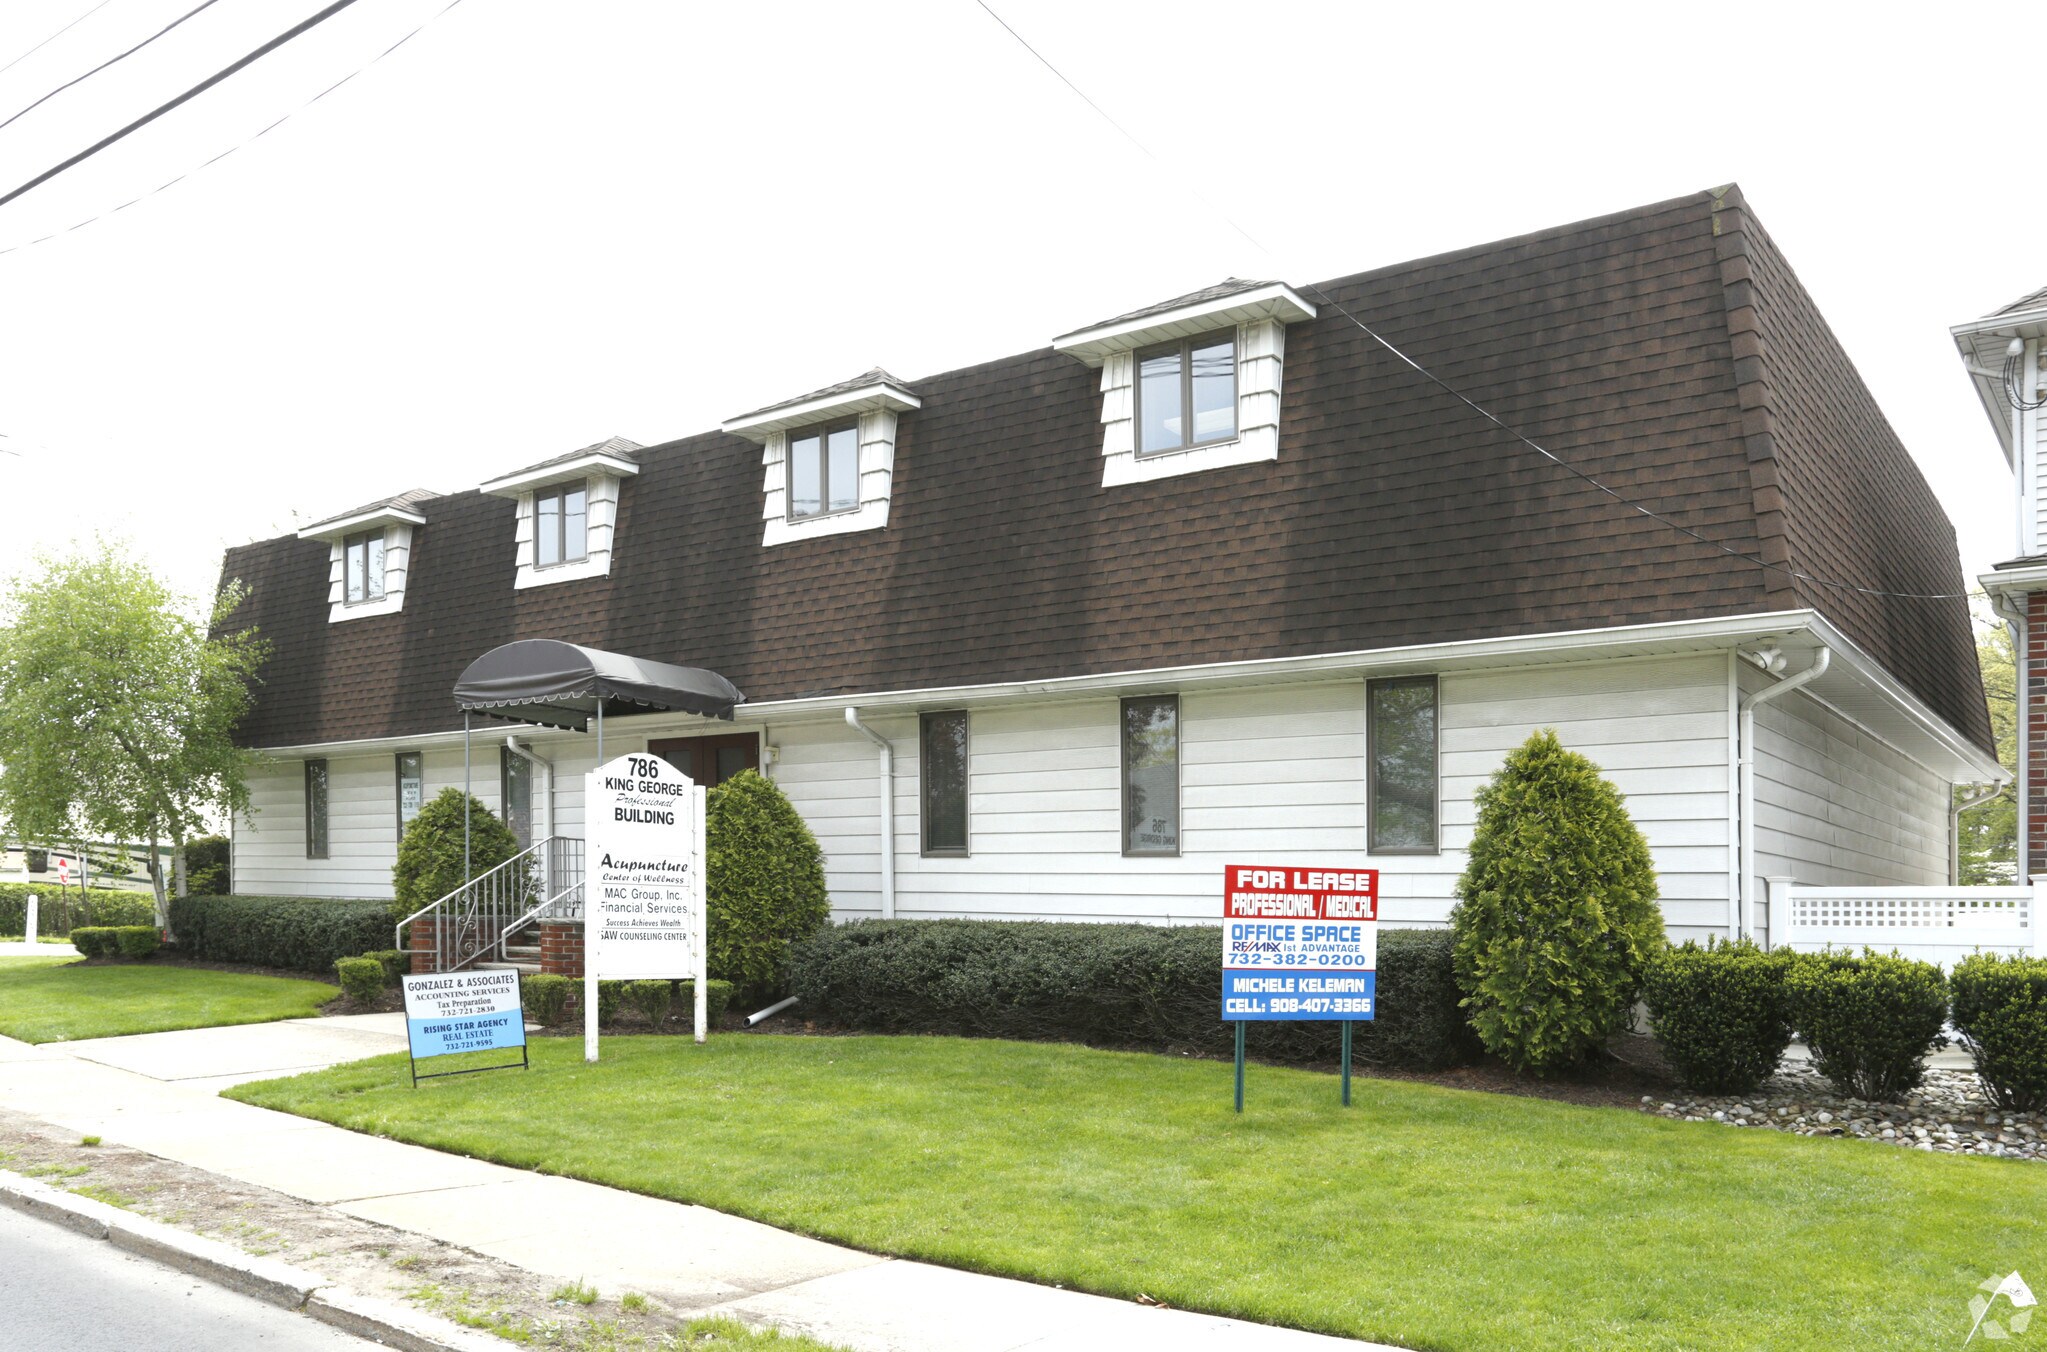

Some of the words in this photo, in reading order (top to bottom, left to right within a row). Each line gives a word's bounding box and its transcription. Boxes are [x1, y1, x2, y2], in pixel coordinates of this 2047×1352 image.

[628, 757, 659, 779] 786
[605, 777, 634, 791] KING
[638, 781, 683, 797] GEORGE
[615, 793, 676, 808] Professional
[615, 807, 675, 825] BUILDING
[601, 853, 688, 872] Acupuncture
[602, 873, 630, 881] Center
[632, 874, 642, 883] of
[643, 874, 684, 885] Wellness
[1237, 870, 1286, 889] FOR
[1293, 871, 1370, 892] LEASE
[605, 888, 627, 899] MAC
[666, 890, 683, 901] Inc.
[646, 902, 688, 914] Services
[1231, 892, 1317, 917] PROFESSIONAL
[1325, 894, 1374, 919] MEDICAL
[606, 918, 630, 927] Success
[631, 918, 659, 928] Achieves
[660, 919, 681, 927] Wealth
[619, 932, 662, 942] COUNSELING
[664, 932, 687, 941] CENTER
[1231, 924, 1295, 942] OFFICE
[1301, 925, 1361, 943] SPACE
[1232, 941, 1282, 953] RE/MAX
[1301, 944, 1360, 953] ADVANTAGE
[1228, 953, 1366, 966] 732-382-0200
[408, 980, 454, 991] GONZALEZ
[456, 979, 464, 988] &
[466, 974, 515, 987] ASSOCIATES
[1233, 978, 1295, 993] MICHELE
[1298, 978, 1365, 993] KELEMAN
[414, 990, 470, 1001] ACCOUNTING
[471, 987, 511, 997] SERVICES
[437, 1001, 451, 1009] Tax
[451, 997, 492, 1008] Preparation
[1226, 998, 1266, 1013] CELL:
[1270, 998, 1371, 1013] 908-407-3366
[441, 1005, 496, 1016] 732-721-2830
[423, 1024, 453, 1034] RISING
[454, 1021, 475, 1031] STAR
[477, 1018, 509, 1029] AGENCY
[442, 1032, 464, 1041] REAL
[465, 1028, 494, 1039] ESTATE
[445, 1039, 493, 1050] 732-721-9595
